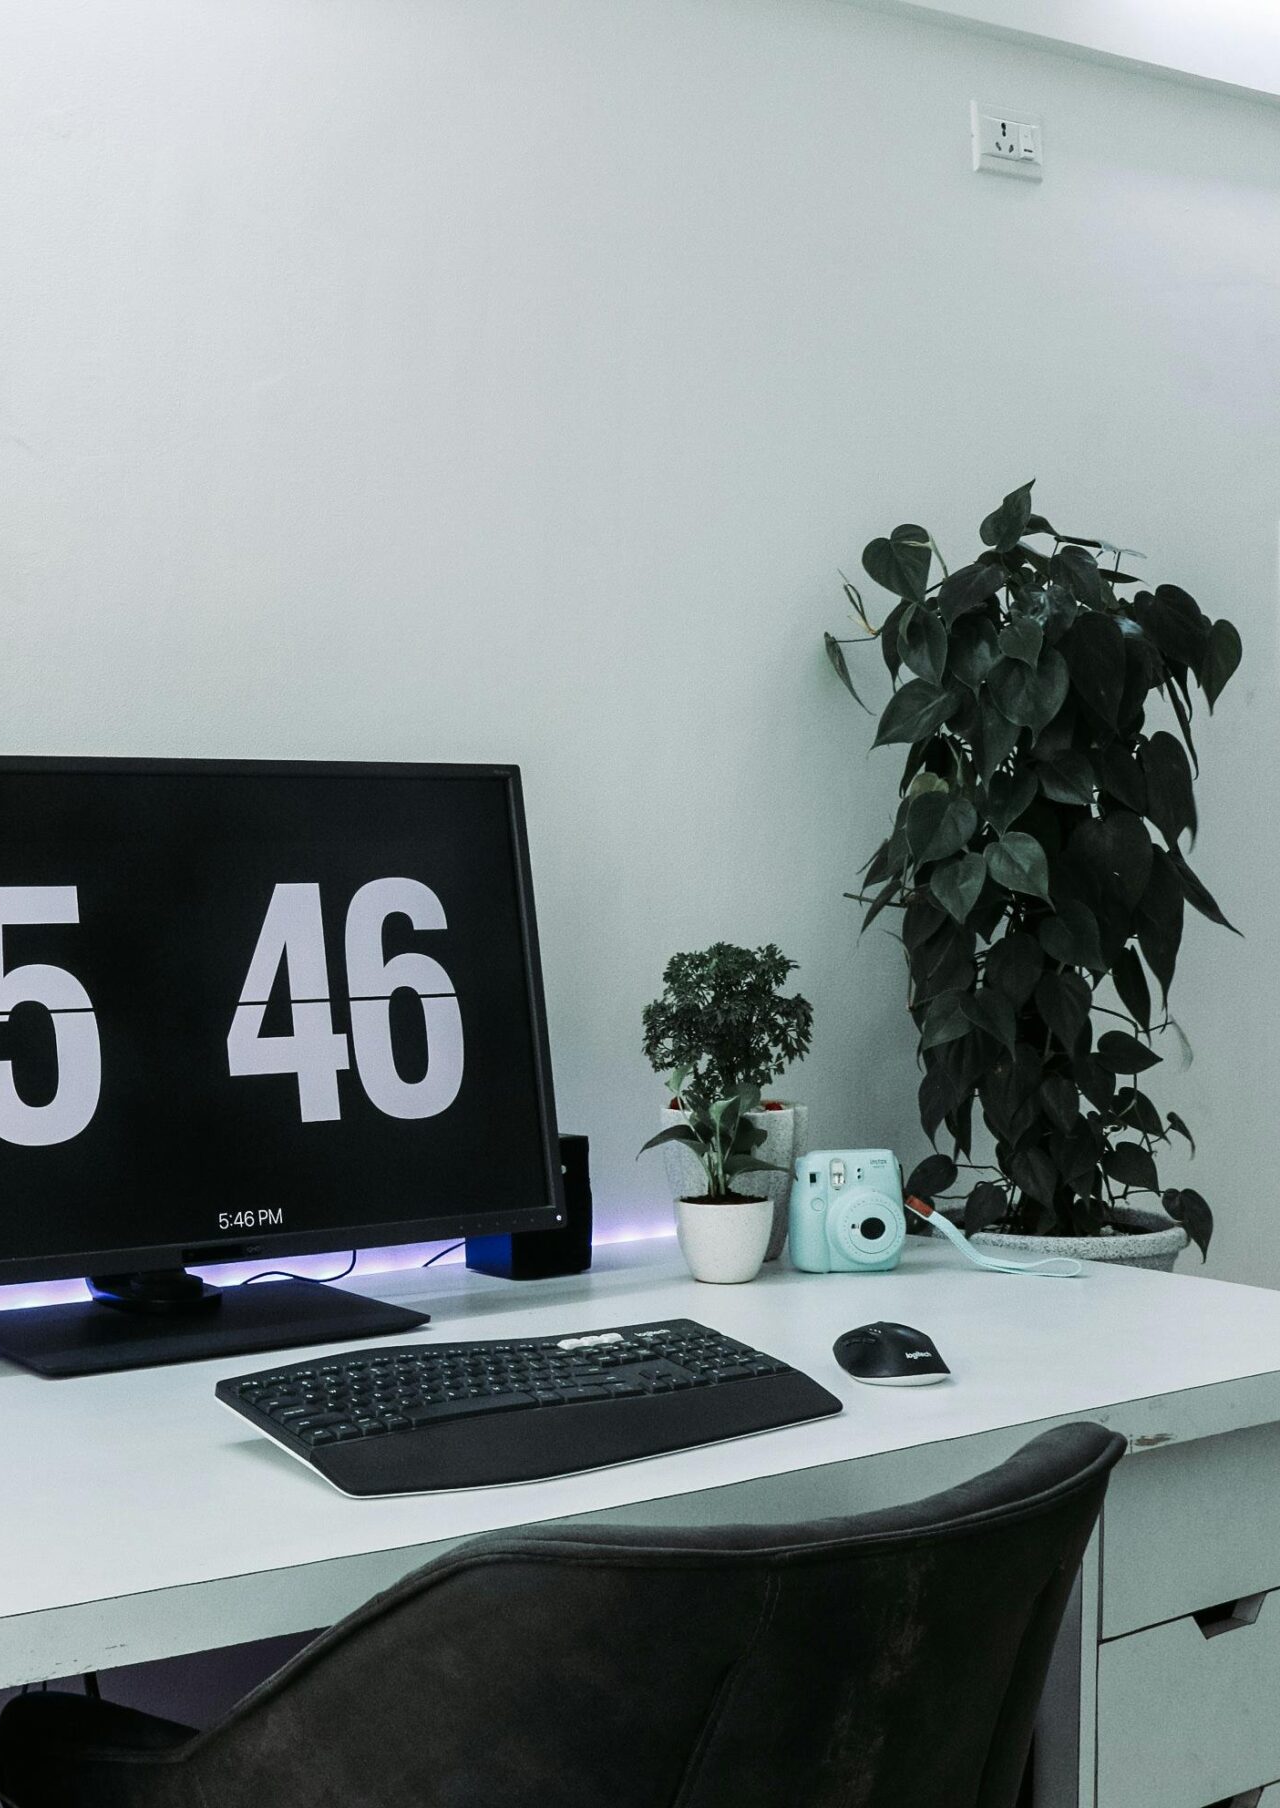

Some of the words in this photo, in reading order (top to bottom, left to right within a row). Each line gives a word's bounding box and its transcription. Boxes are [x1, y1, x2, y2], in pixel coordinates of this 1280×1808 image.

[226, 876, 465, 1123] 46
[218, 1210, 255, 1230] 5:46
[258, 1207, 283, 1226] PM
